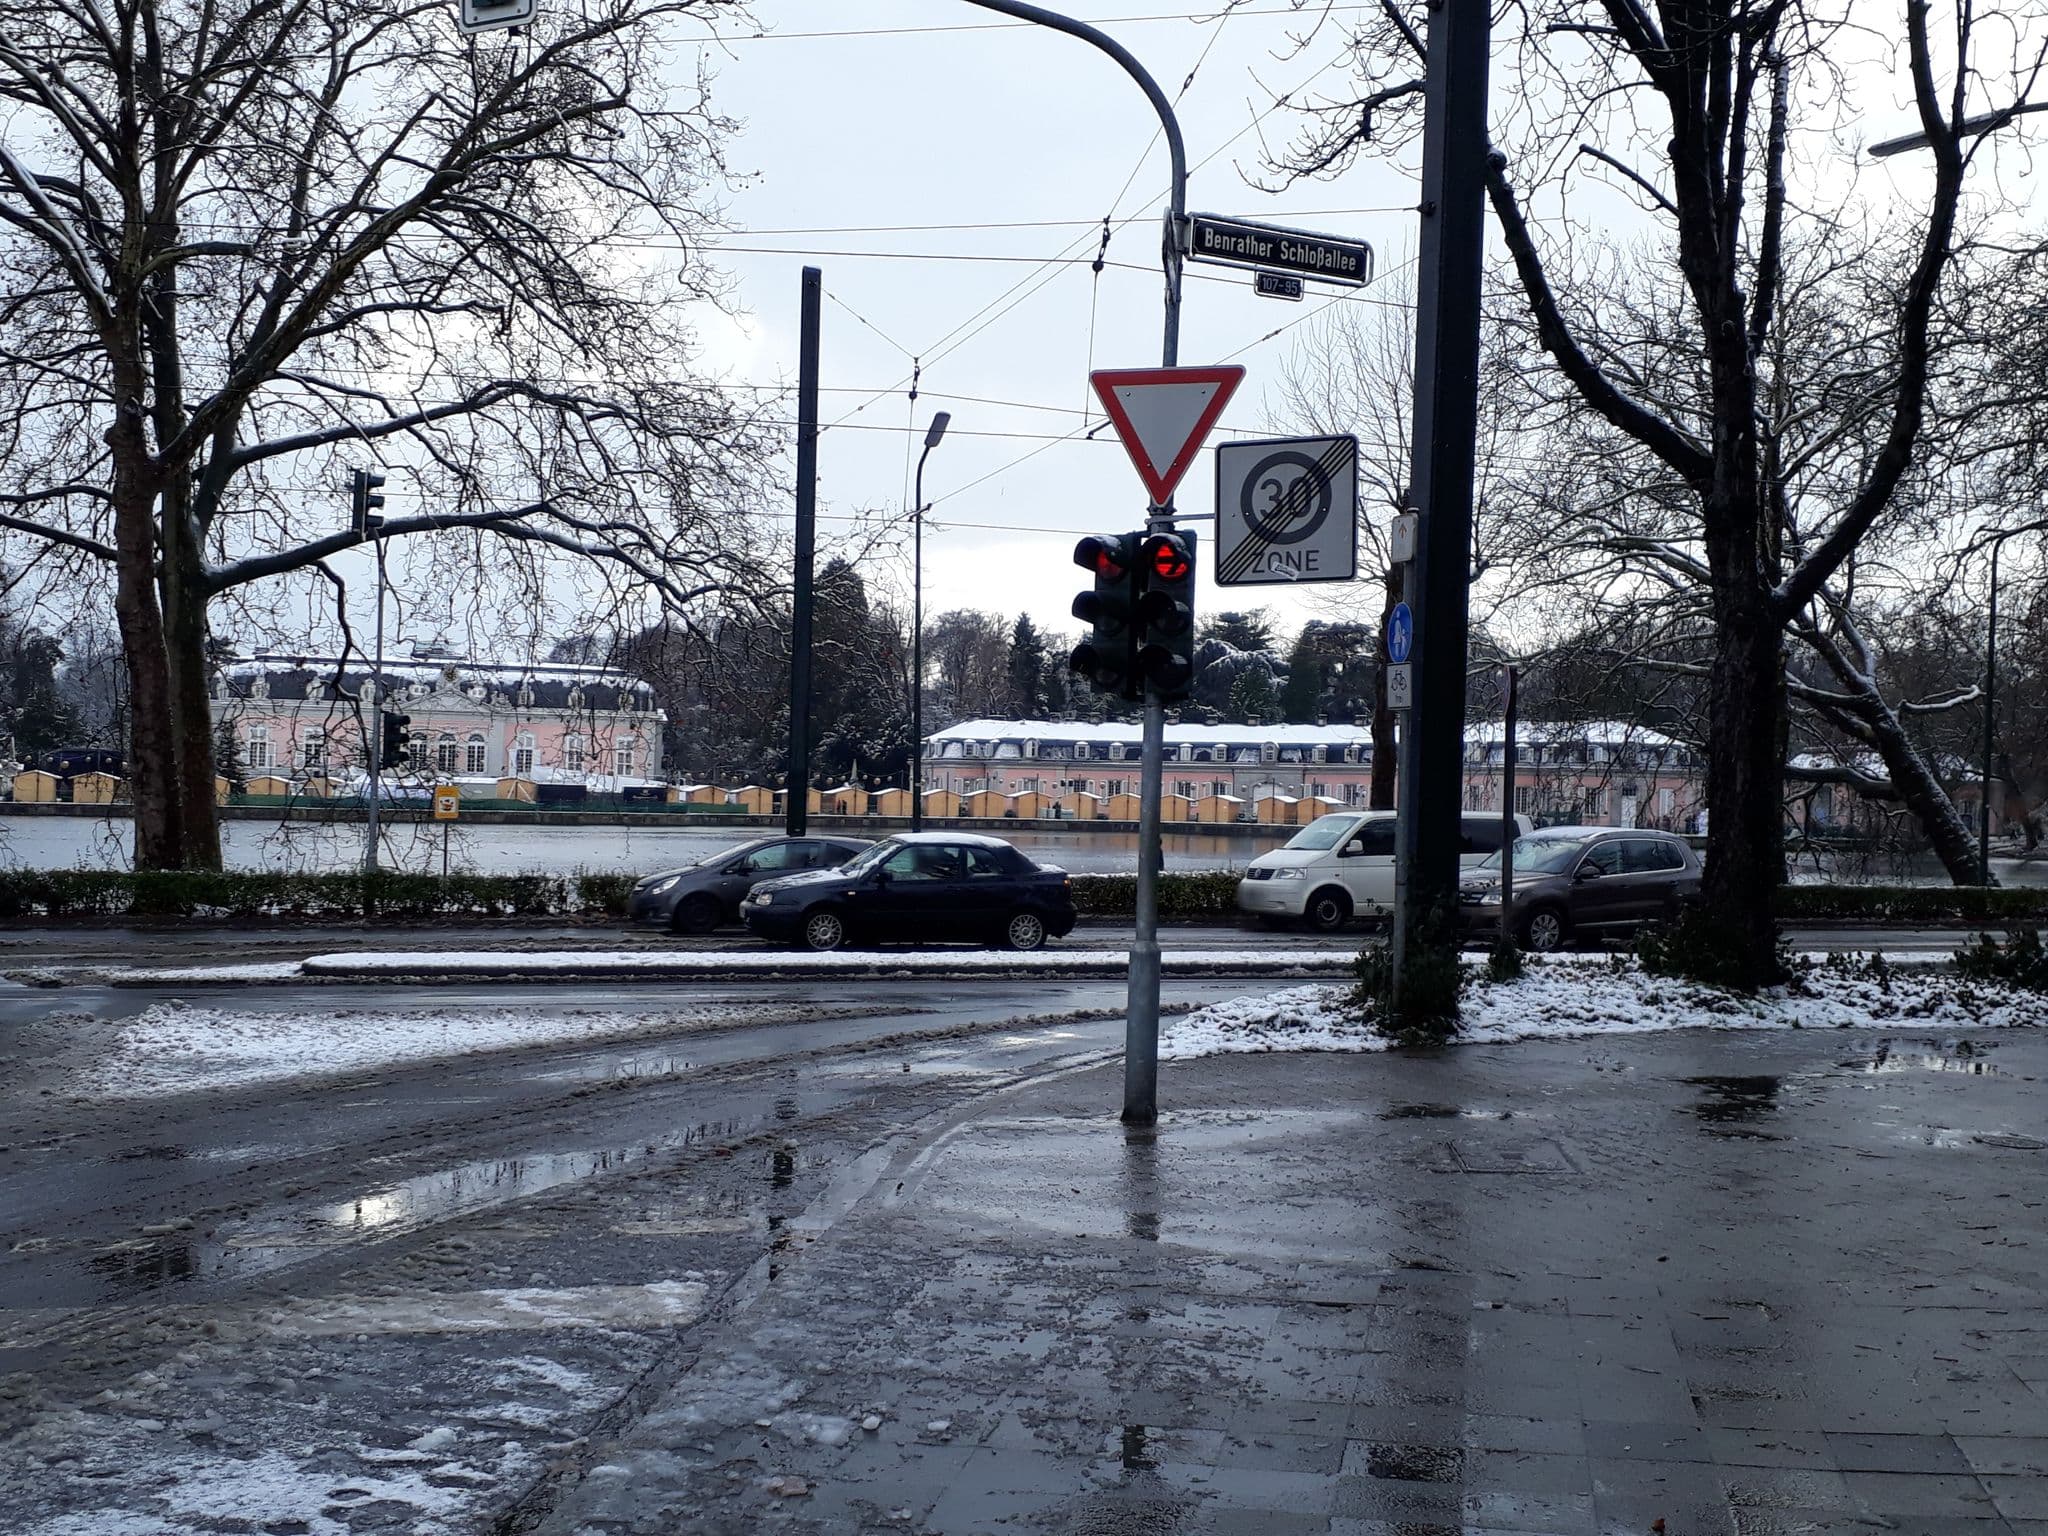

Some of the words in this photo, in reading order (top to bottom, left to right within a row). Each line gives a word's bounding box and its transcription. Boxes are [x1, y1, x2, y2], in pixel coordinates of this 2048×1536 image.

[1204, 227, 1273, 258] Benrather
[1280, 240, 1356, 271] Schloßallee
[1262, 276, 1298, 295] 107-95
[1260, 476, 1312, 518] 30
[1252, 550, 1320, 574] ZONE
